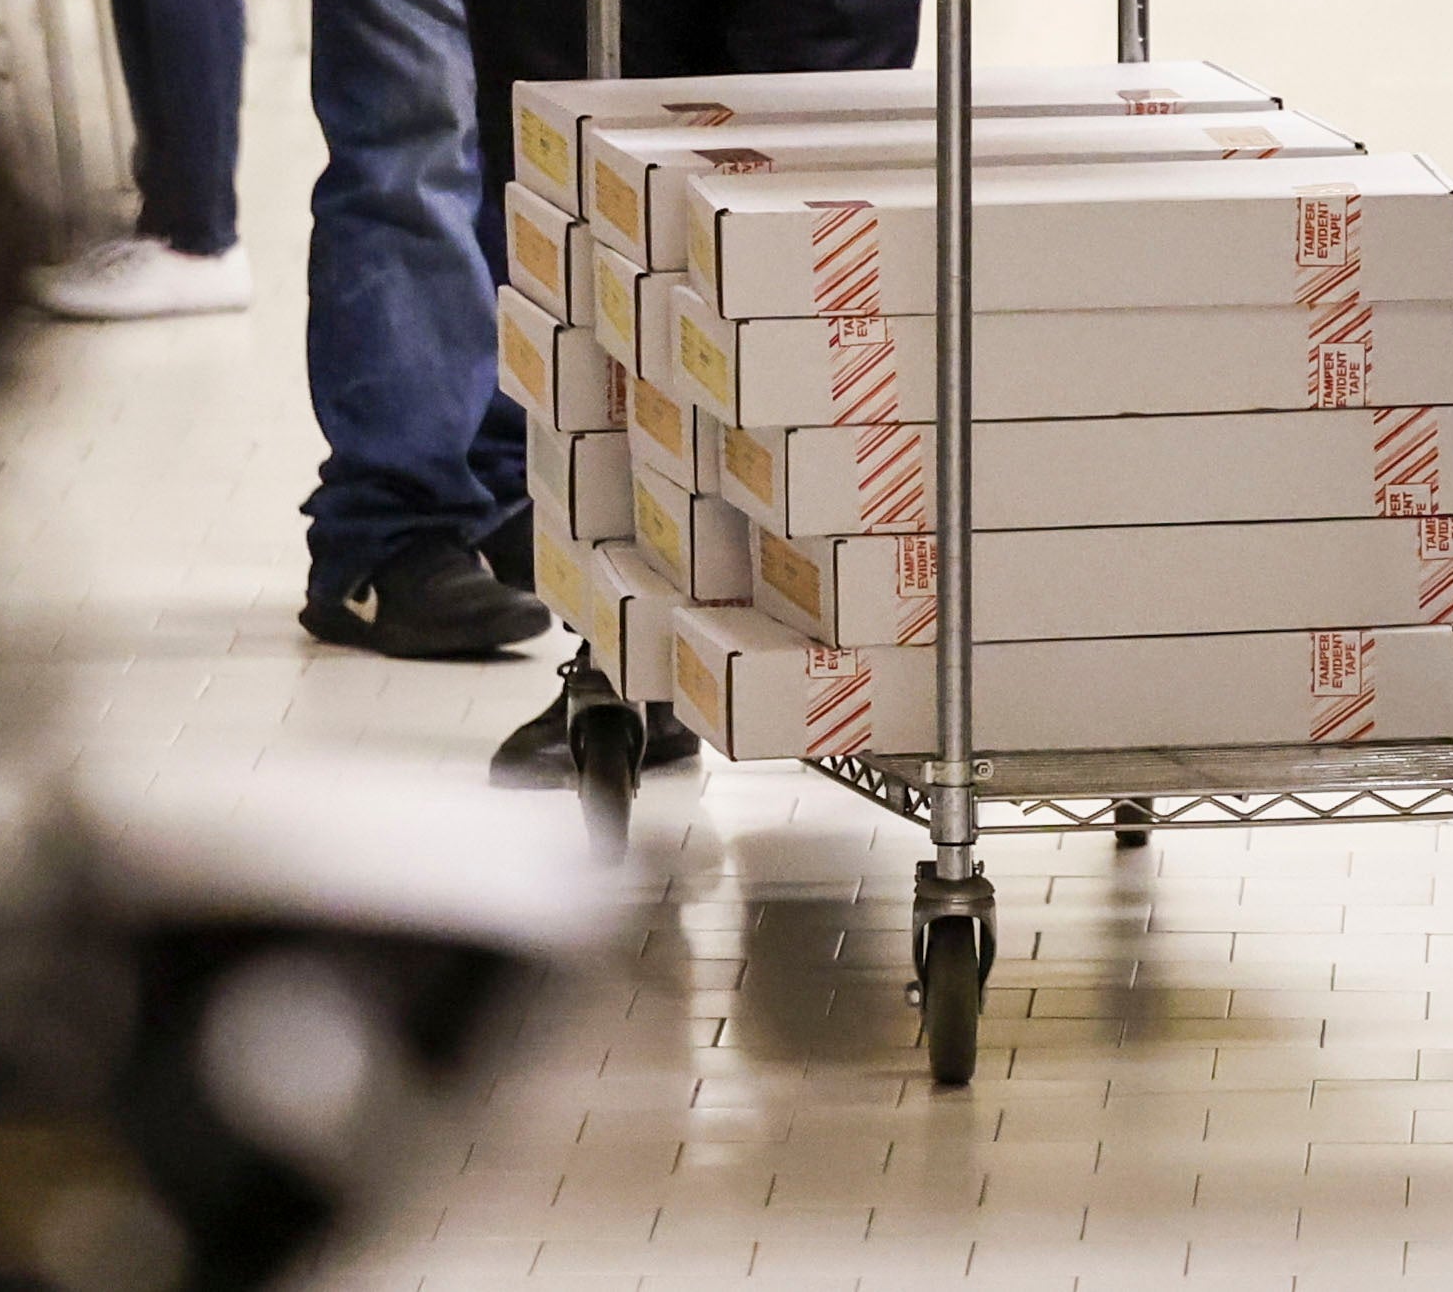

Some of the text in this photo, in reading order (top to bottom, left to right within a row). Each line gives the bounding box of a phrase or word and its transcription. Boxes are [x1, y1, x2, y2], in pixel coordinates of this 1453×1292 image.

[1304, 202, 1315, 257] TAMPER
[1317, 201, 1329, 259] EVIDENT
[1330, 213, 1342, 247] TAPE
[1323, 351, 1334, 407] TAMPER
[1336, 351, 1347, 408] EVIDENT
[1349, 362, 1360, 395] TAPE
[1319, 634, 1330, 687] TAMPER
[1332, 633, 1343, 688] EVIDENT
[1345, 643, 1356, 676] TAPE
